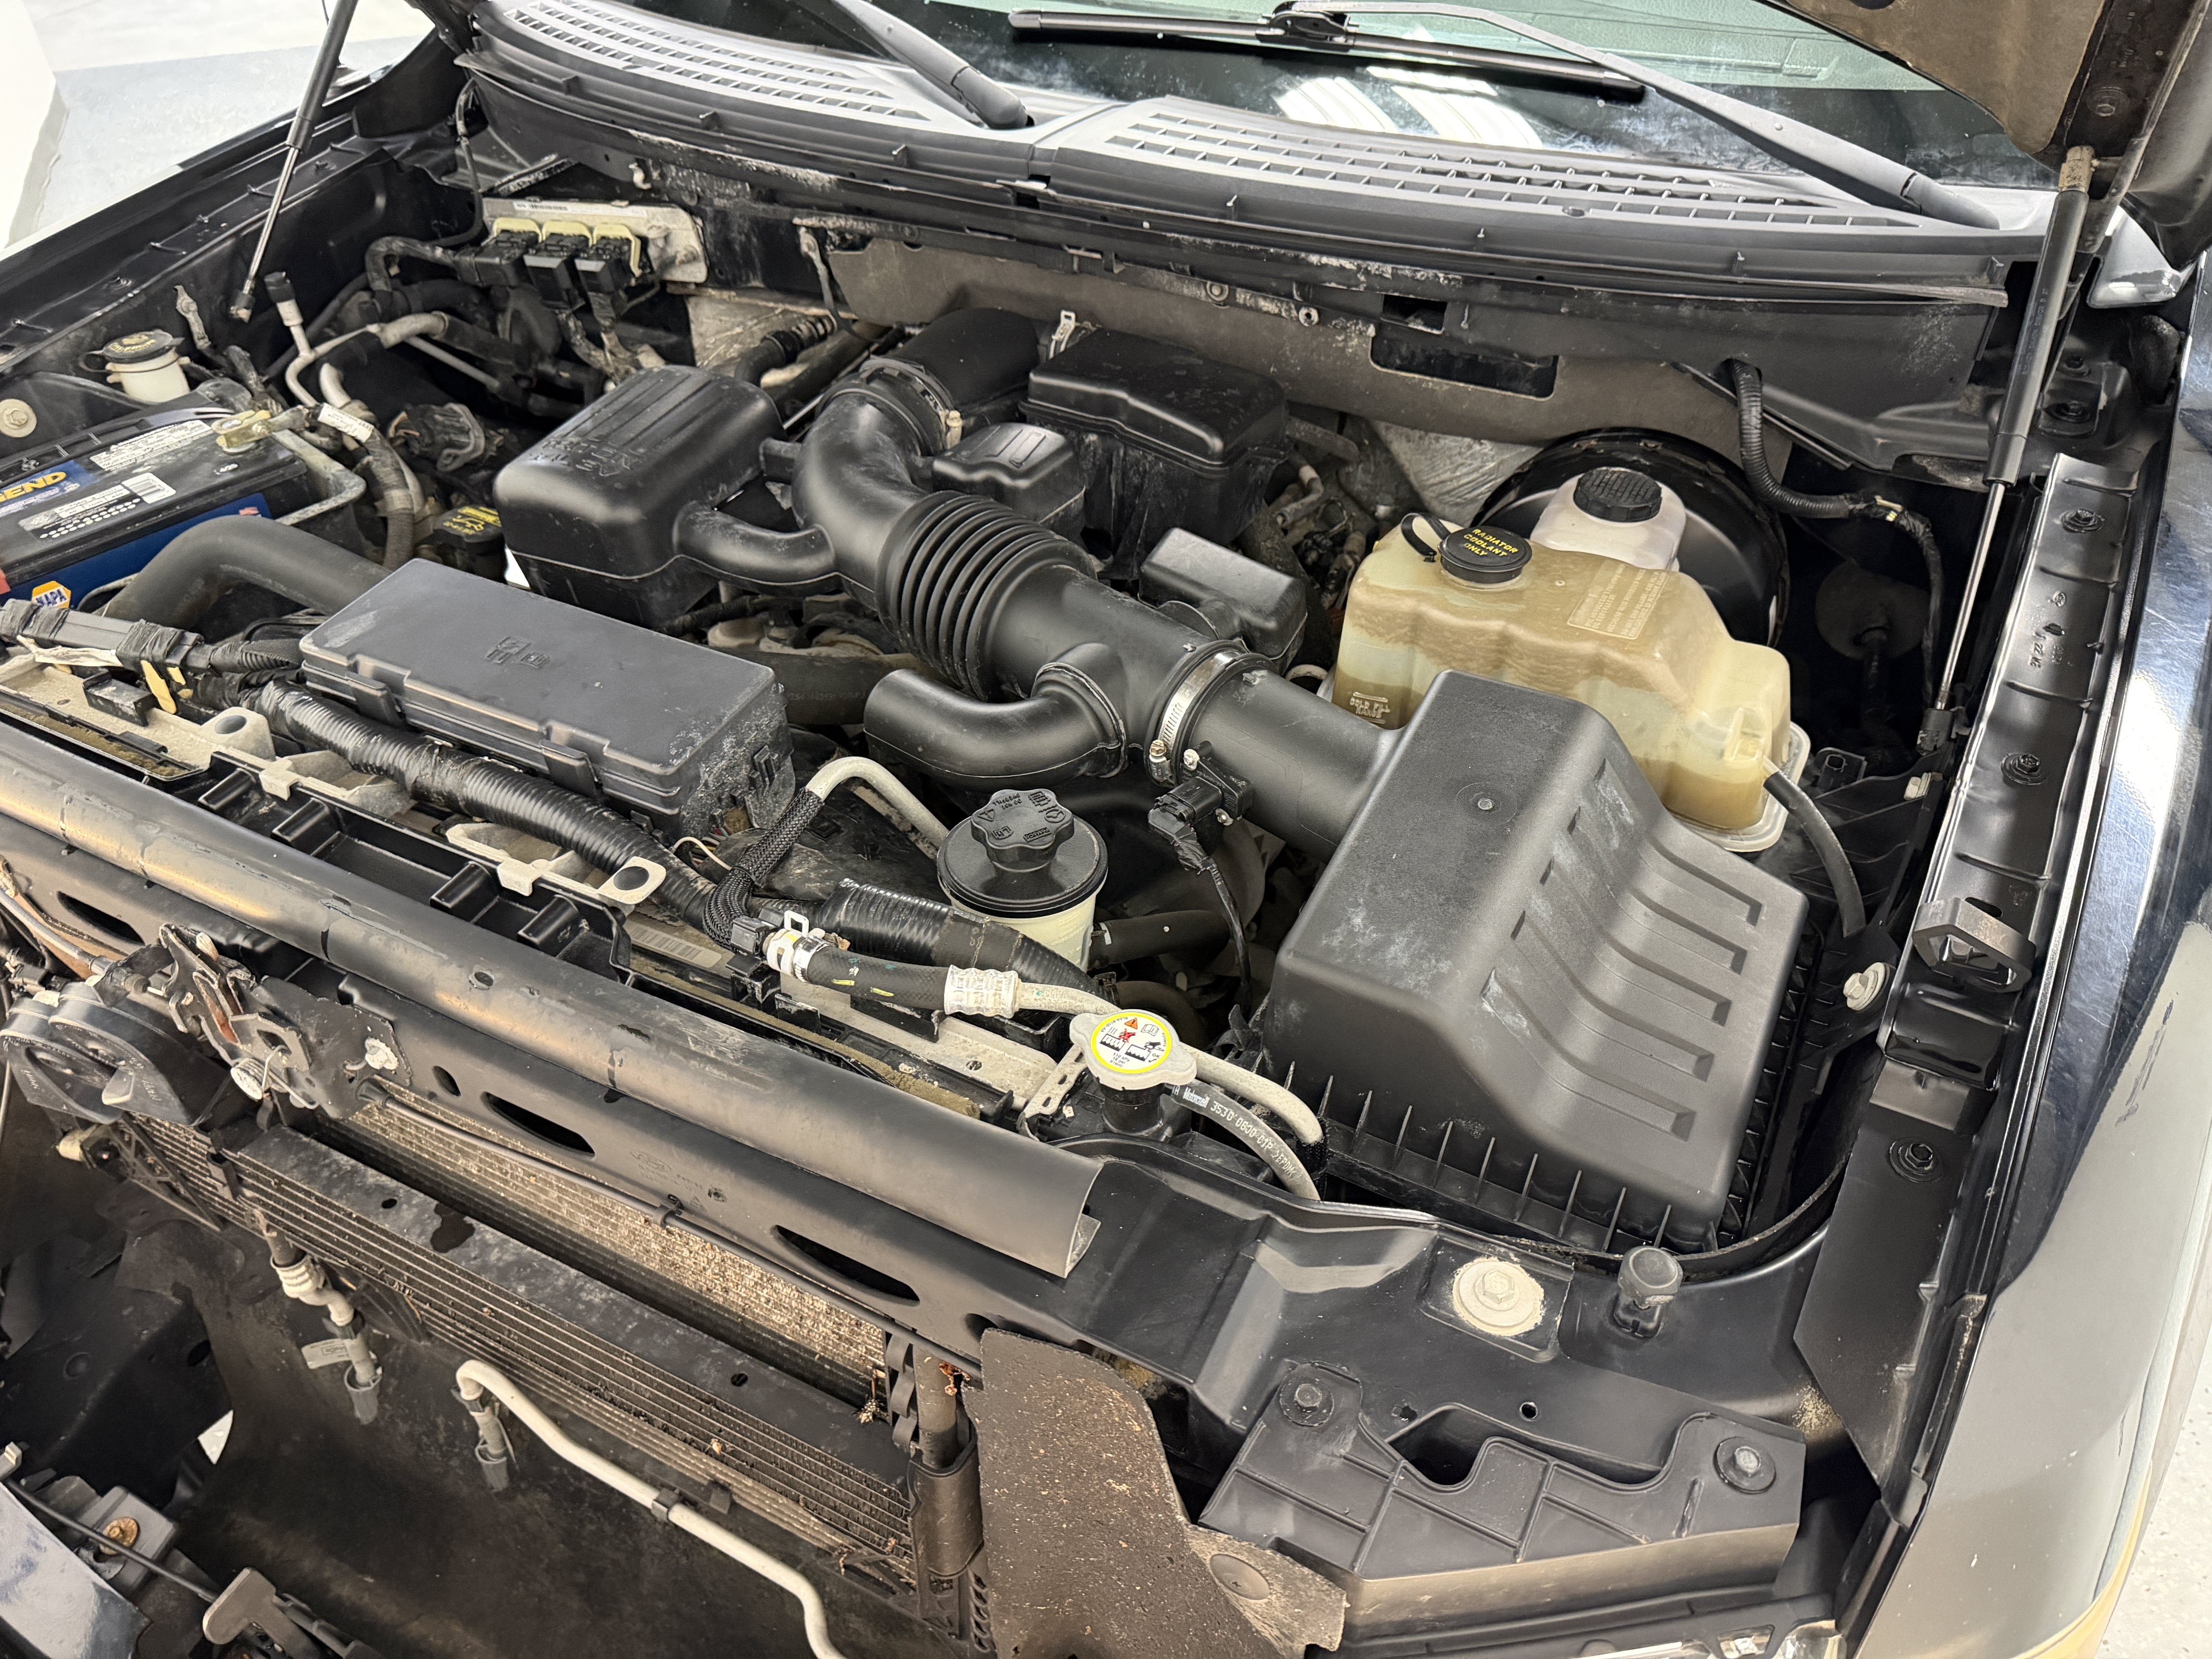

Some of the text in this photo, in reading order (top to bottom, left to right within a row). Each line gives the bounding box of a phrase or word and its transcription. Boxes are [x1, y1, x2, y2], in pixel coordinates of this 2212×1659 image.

[0, 472, 67, 502] END
[1463, 543, 1488, 556] ONLY
[1464, 534, 1507, 556] COOLANT
[1472, 529, 1518, 553] RADIATOR
[36, 589, 67, 606] NAPA
[1350, 697, 1391, 713] COLD FILL
[1355, 707, 1382, 718] RANGE
